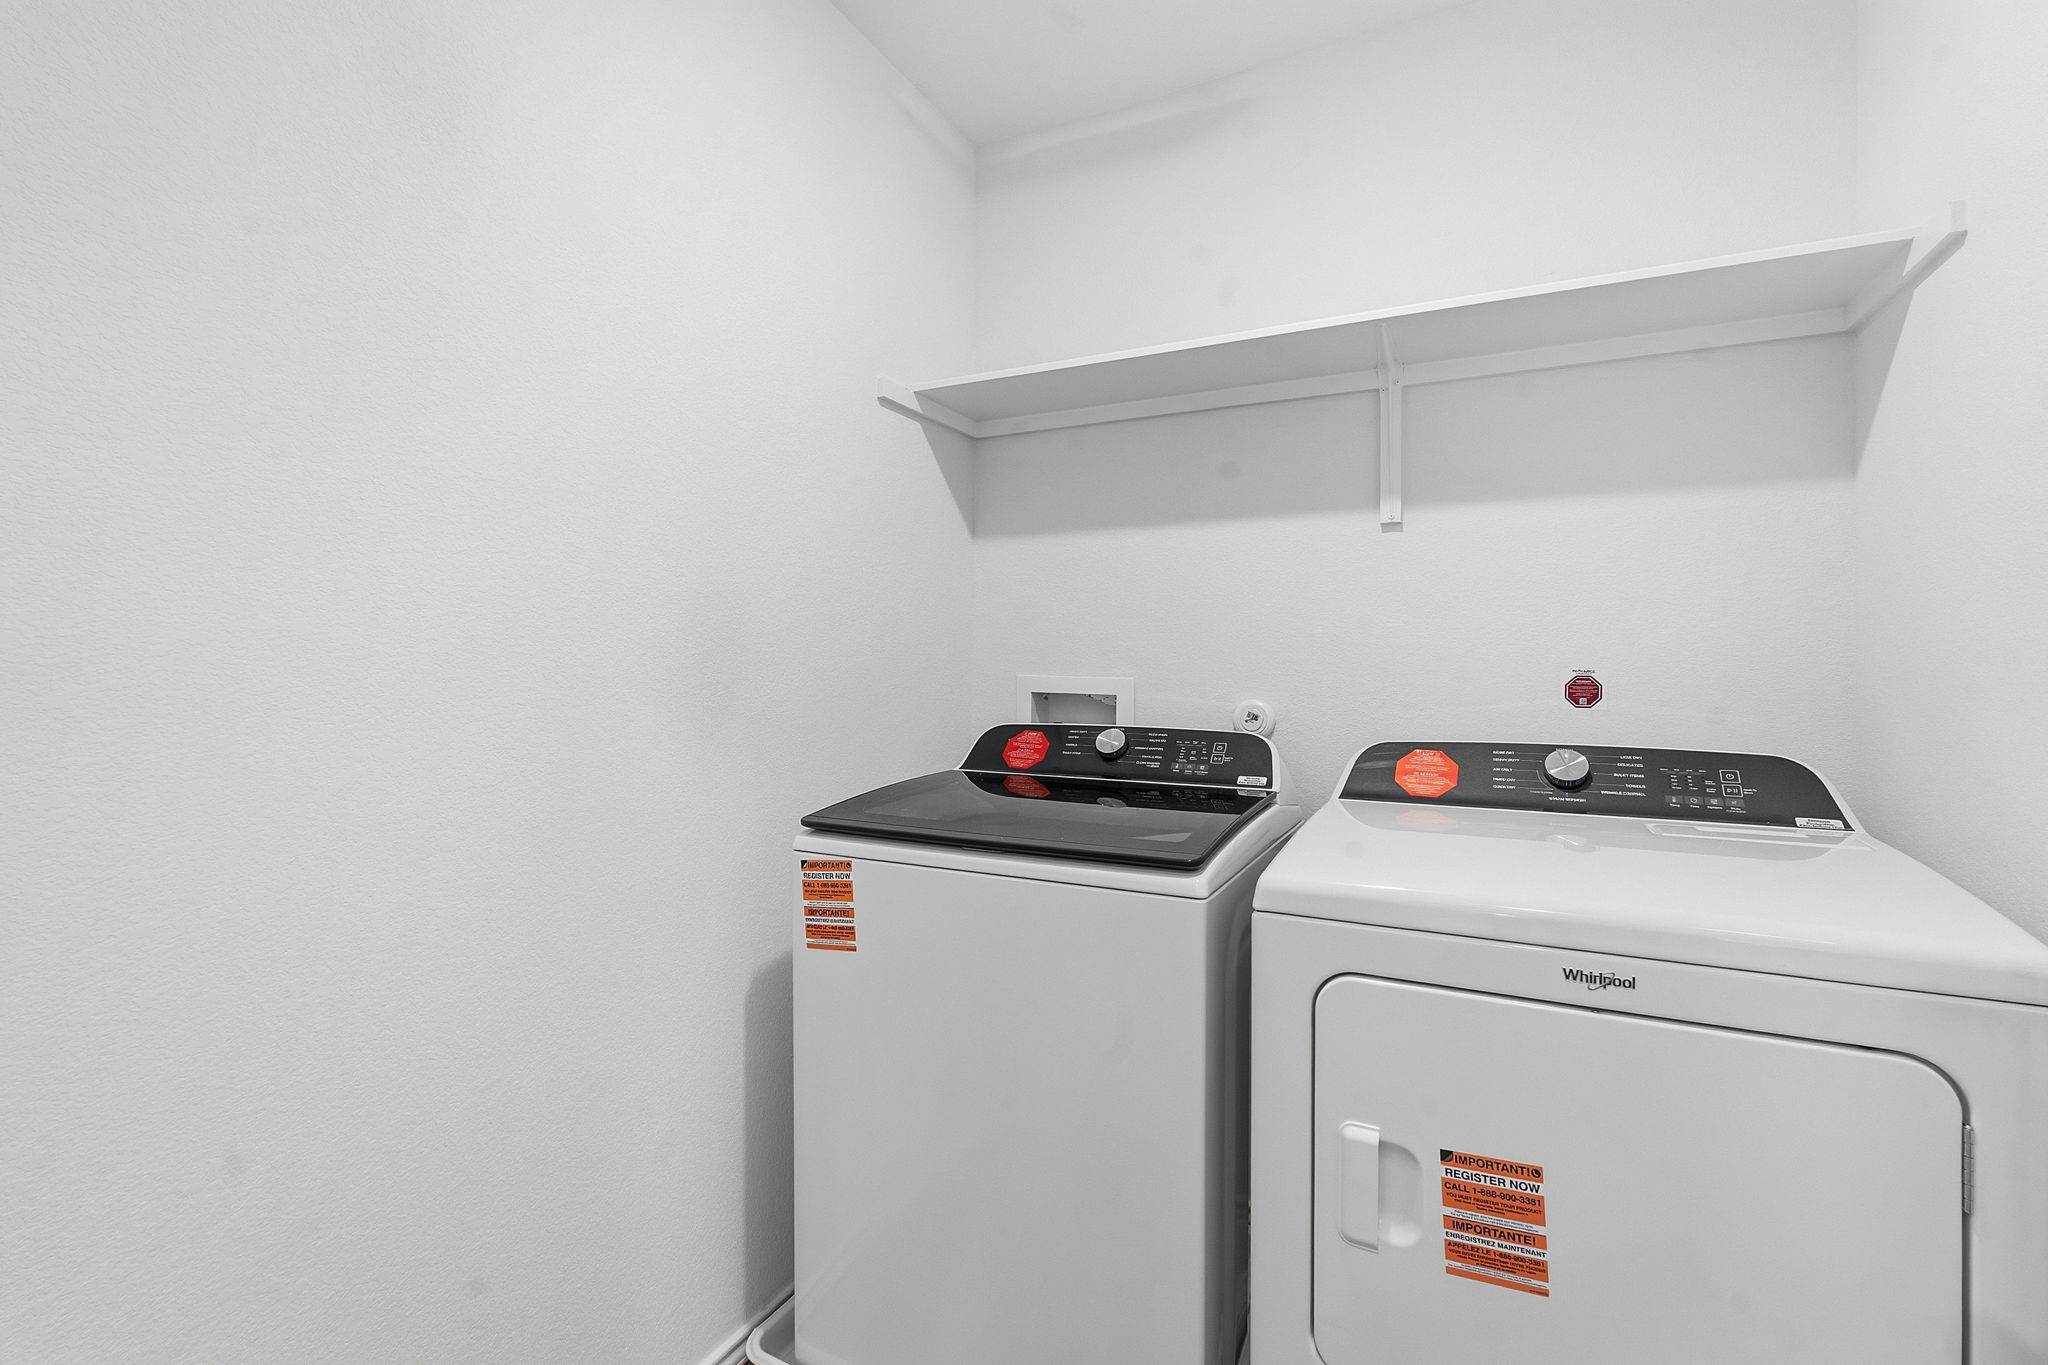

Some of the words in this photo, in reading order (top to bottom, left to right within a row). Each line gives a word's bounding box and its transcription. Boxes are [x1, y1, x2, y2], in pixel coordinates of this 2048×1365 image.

[1562, 967, 1636, 990] Whirlpool
[1455, 1154, 1530, 1176] IMPORTANT!
[1444, 1182, 1469, 1193] CALL
[1445, 1168, 1506, 1187] REGISTER
[1510, 1180, 1540, 1193] NOW
[1445, 1231, 1495, 1247] ENREGISTREZ
[1497, 1242, 1547, 1258] MAINTENANT
[1452, 1220, 1536, 1246] IMPORTANTE!
